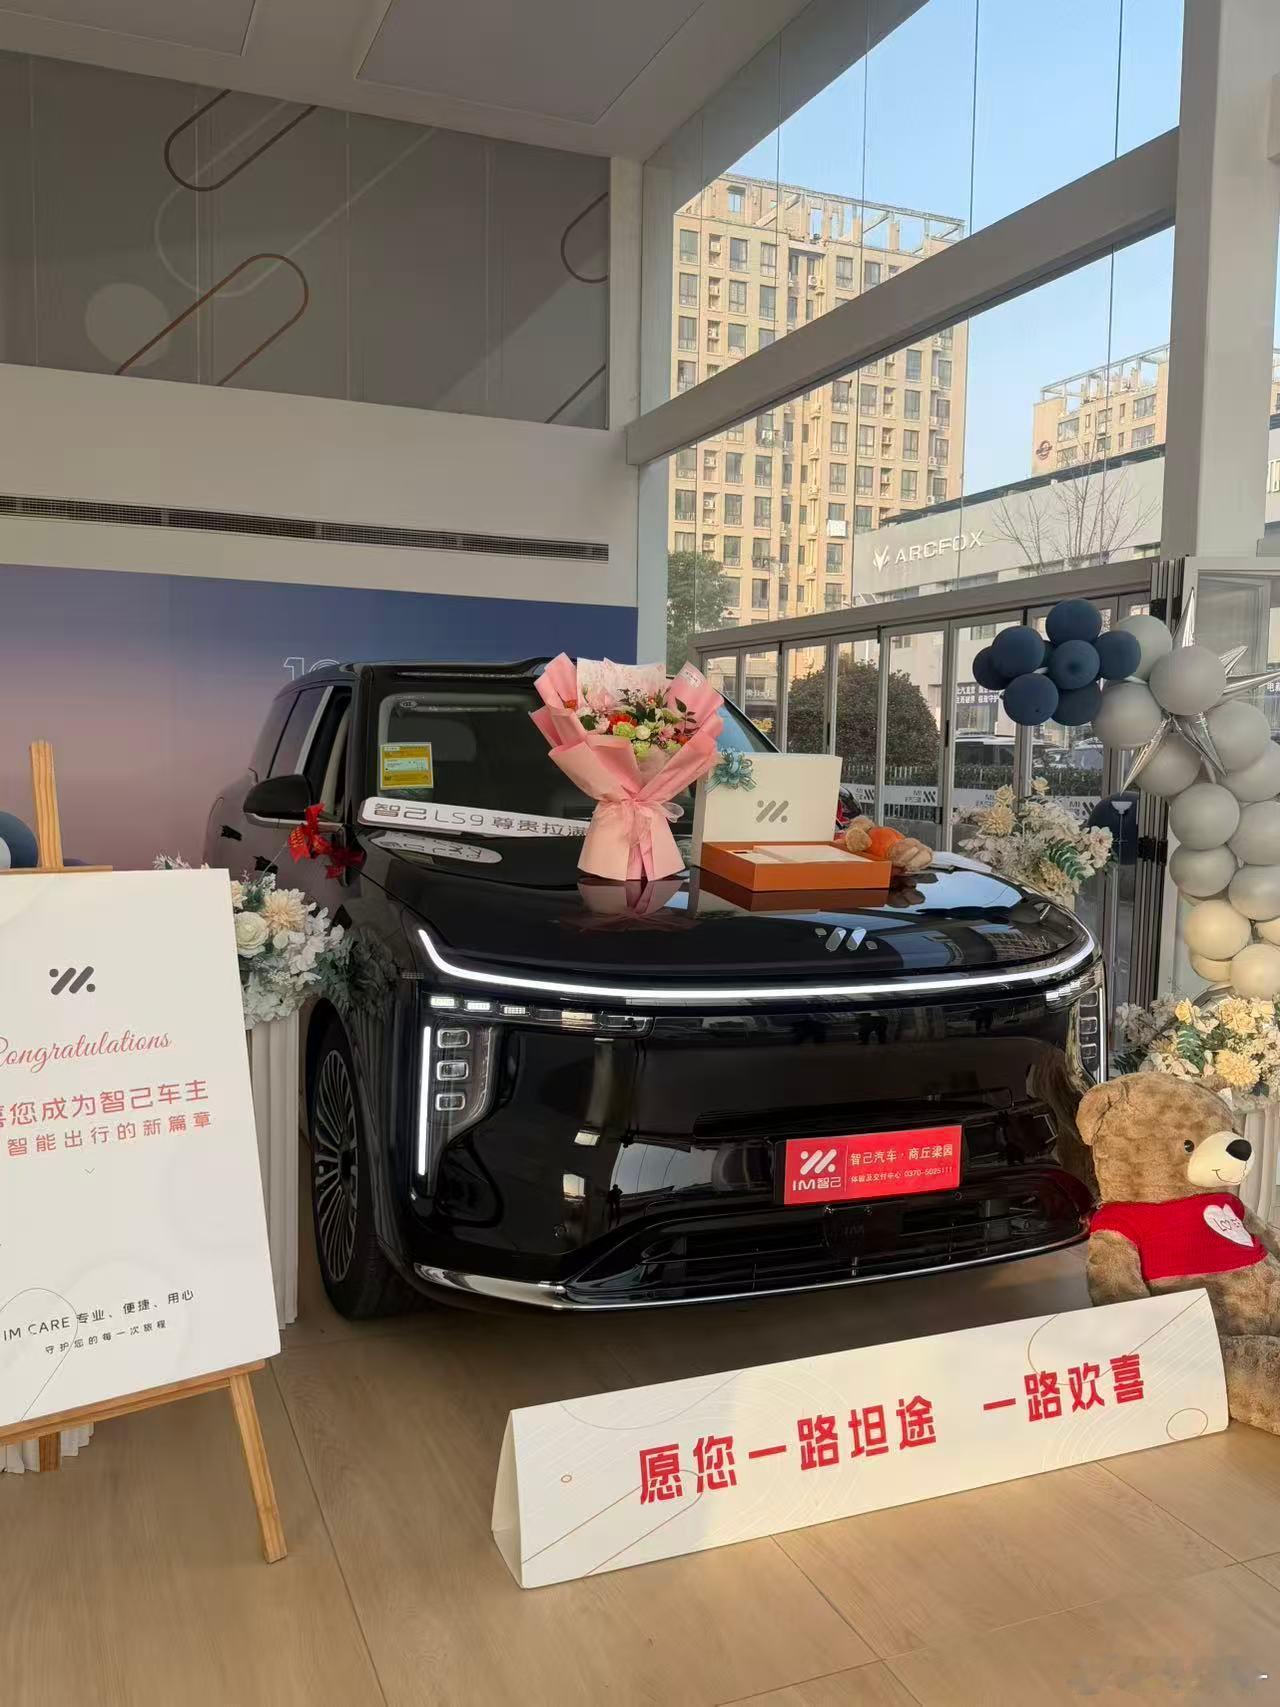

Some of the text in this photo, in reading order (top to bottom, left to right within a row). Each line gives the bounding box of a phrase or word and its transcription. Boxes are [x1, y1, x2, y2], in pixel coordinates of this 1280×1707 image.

[895, 528, 984, 564] ARCFOX
[374, 803, 427, 820] 智己
[434, 810, 484, 827] LS9
[0, 1079, 209, 1128] 您成为智己车主
[7, 1111, 212, 1157] 智能出行的新篇章
[792, 1176, 842, 1191] IM智己
[3, 1327, 22, 1341] IM
[28, 1316, 71, 1336] CARE
[45, 1319, 167, 1355] 守护您的每一次旅程
[638, 1353, 1145, 1506] 愿您一路坦途 一路欢喜
